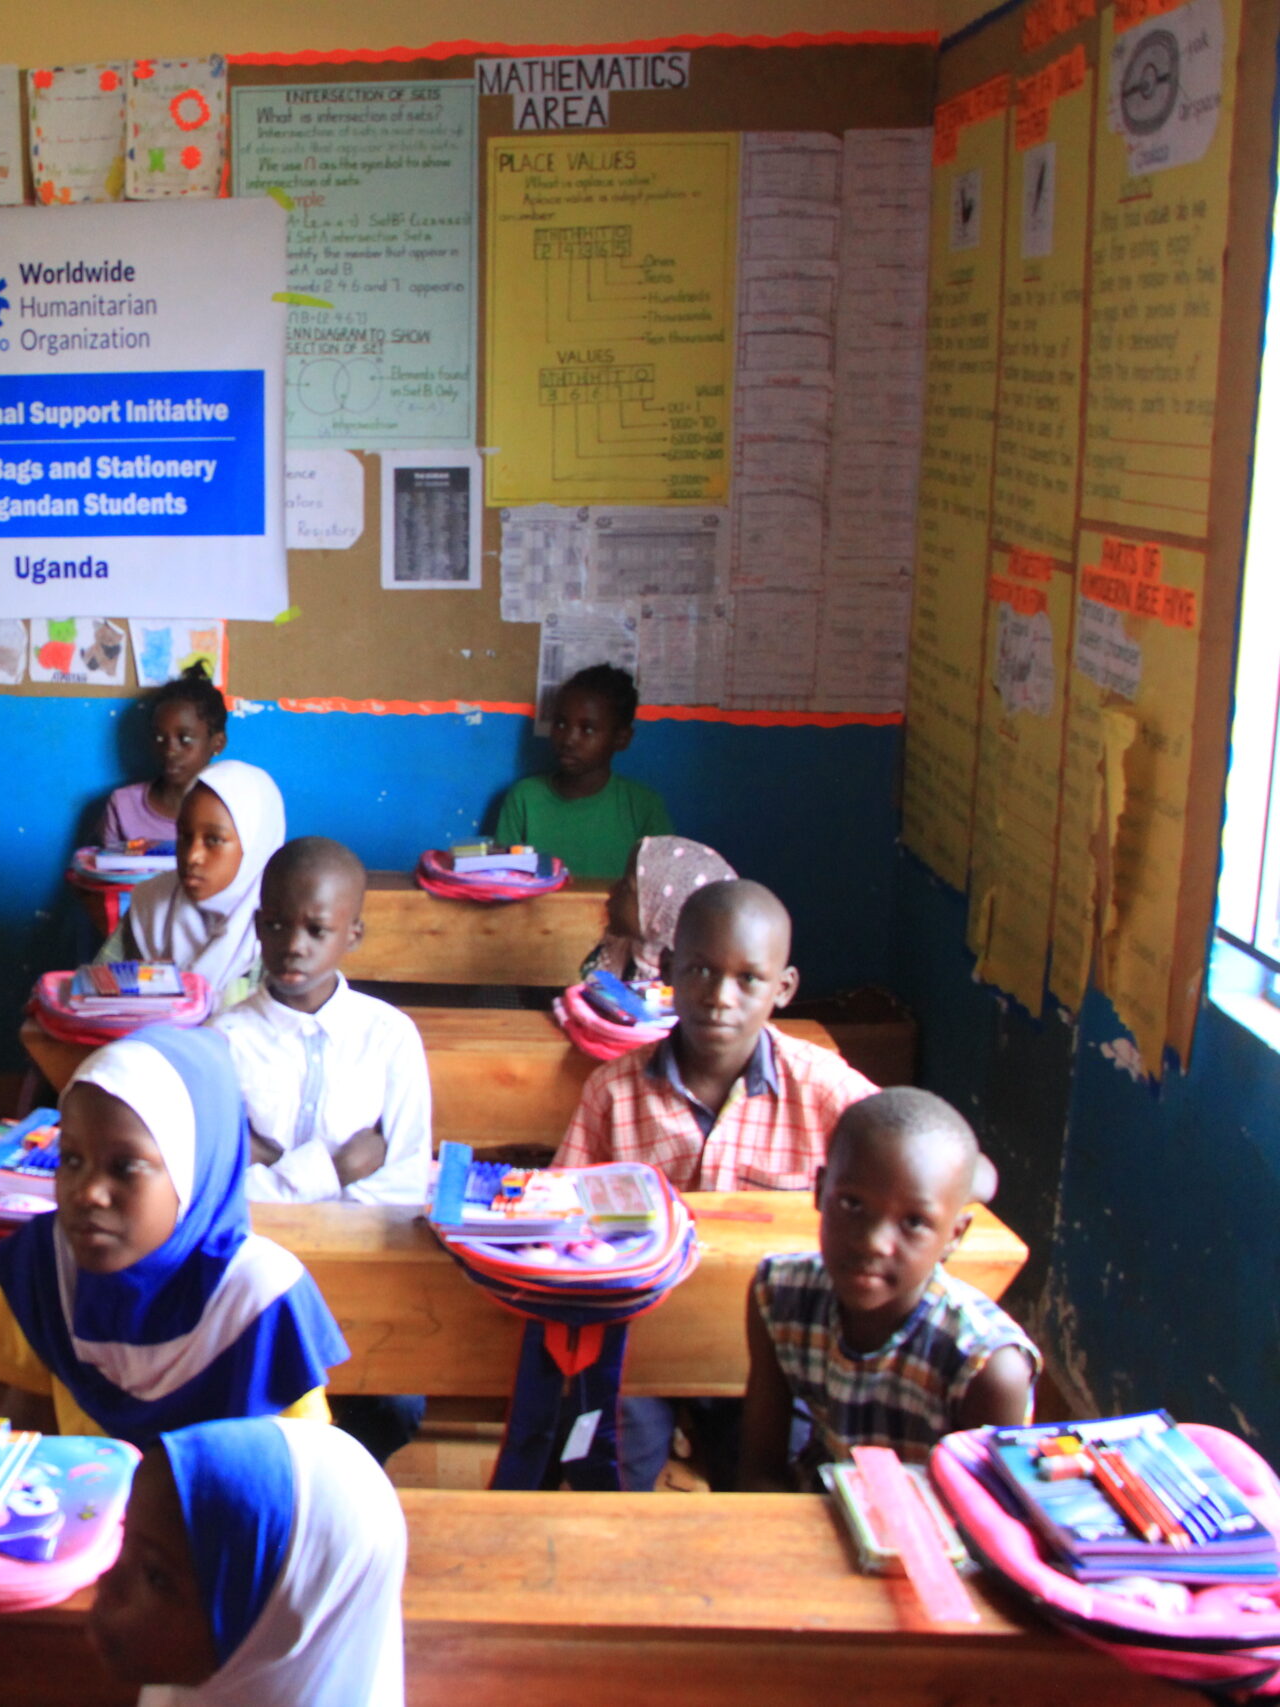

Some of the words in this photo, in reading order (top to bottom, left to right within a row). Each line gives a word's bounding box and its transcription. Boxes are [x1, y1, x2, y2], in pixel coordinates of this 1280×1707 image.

[478, 54, 686, 94] MATHEMATICS
[286, 88, 384, 104] INTERSECTION
[411, 86, 441, 101] SETS
[257, 106, 293, 123] What
[518, 95, 607, 129] AREA
[499, 152, 555, 173] PLACE
[567, 150, 636, 171] VALUES
[18, 259, 137, 285] Worldwide
[20, 292, 159, 319] Humanitarian
[20, 326, 152, 357] Organization
[370, 328, 387, 341] TO
[391, 328, 432, 342] SHOW
[557, 350, 615, 365] VALUES
[29, 400, 122, 428] Support
[125, 397, 230, 422] Initiative
[49, 456, 91, 480] and
[97, 454, 217, 483] Stationery
[84, 491, 189, 516] Students
[14, 554, 110, 585] Uganda
